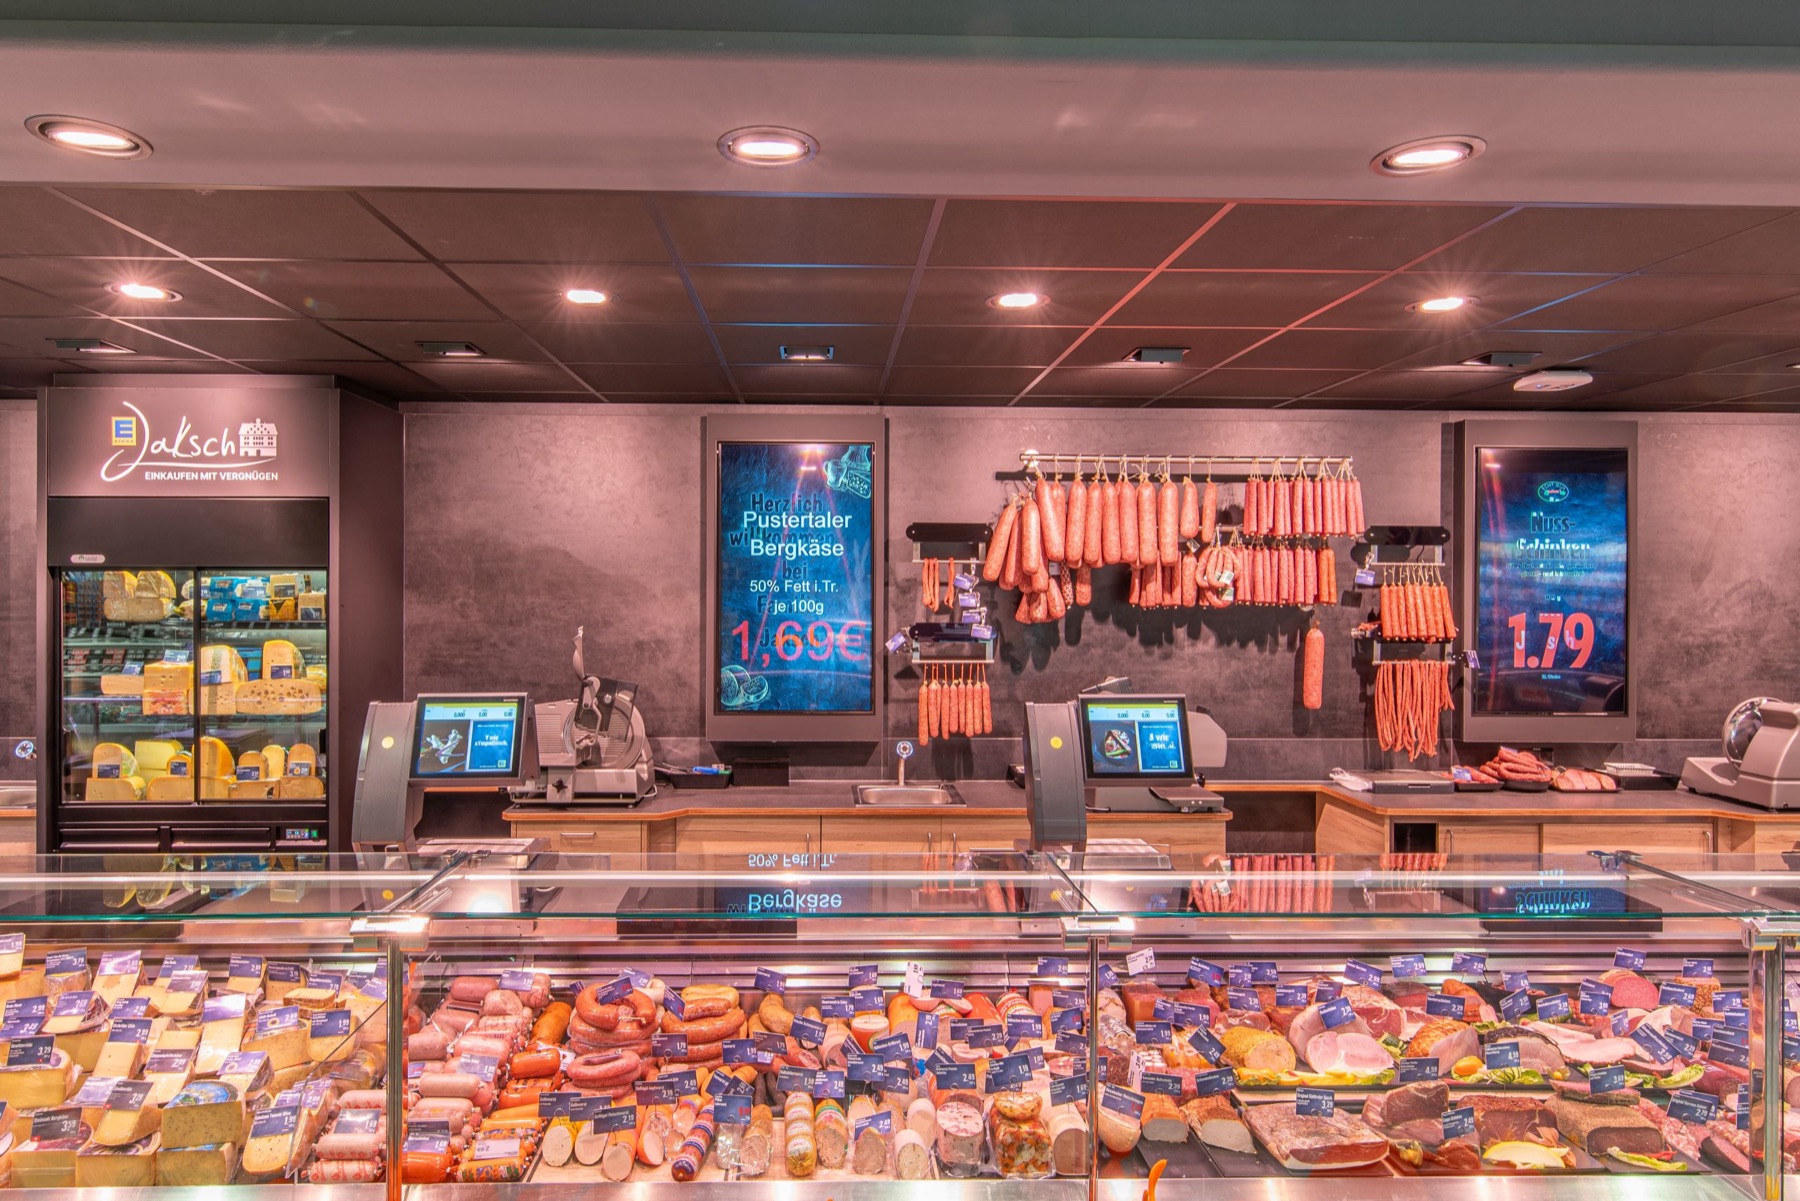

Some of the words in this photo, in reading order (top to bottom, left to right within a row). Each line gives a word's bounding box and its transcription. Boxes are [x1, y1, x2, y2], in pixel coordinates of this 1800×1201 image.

[100, 401, 236, 481] Jaksch
[145, 471, 198, 481] EINKAUFEN
[200, 471, 217, 481] MIT
[219, 470, 278, 481] VERGNÜGEN
[751, 493, 823, 512] Herzlich
[743, 511, 852, 528] Pustertaler
[1530, 512, 1576, 534] Nuss-
[750, 538, 844, 559] Bergkäse
[782, 560, 808, 580] bei
[749, 580, 780, 593] 50%
[784, 580, 810, 593] Fett
[773, 601, 786, 615] je
[791, 601, 824, 615] 100g
[732, 620, 867, 668] 1,69€
[1508, 612, 1594, 669] 1.79
[38, 1046, 52, 1055] 3.29
[872, 1064, 883, 1073] 2.49
[684, 1080, 697, 1089] 2.49
[1321, 1100, 1334, 1109] 3.29
